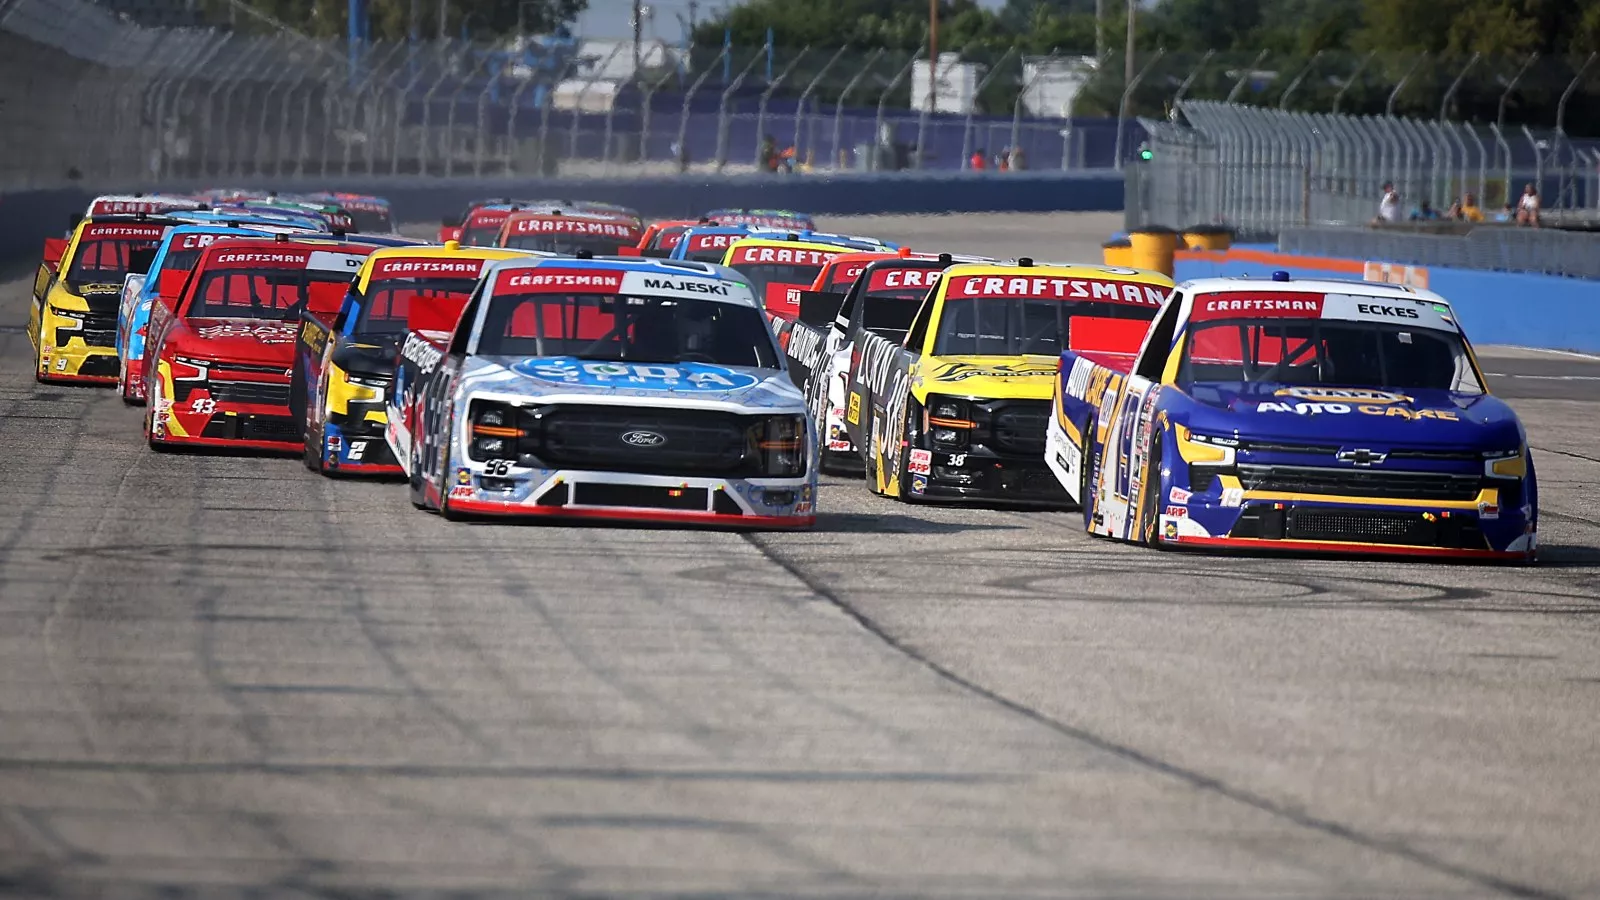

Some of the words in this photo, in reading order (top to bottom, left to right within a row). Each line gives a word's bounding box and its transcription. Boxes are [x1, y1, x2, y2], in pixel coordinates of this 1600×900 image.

[518, 220, 630, 237] CRAFTSMAN
[218, 254, 304, 263] CRAFTSMAN
[383, 263, 477, 272] CRAFTSMAN
[510, 275, 618, 286] CRAFTSMAN
[643, 279, 728, 296] MAJESKI
[964, 278, 1171, 304] CRAFTSMAN
[1207, 300, 1317, 311] CRAFTSMAN
[1357, 303, 1419, 319] ECKES
[192, 399, 215, 413] 43
[1256, 402, 1351, 415] AUTO
[1358, 405, 1460, 421] CARE
[629, 431, 658, 444] Ford
[347, 441, 367, 460] 2
[947, 454, 965, 466] 38
